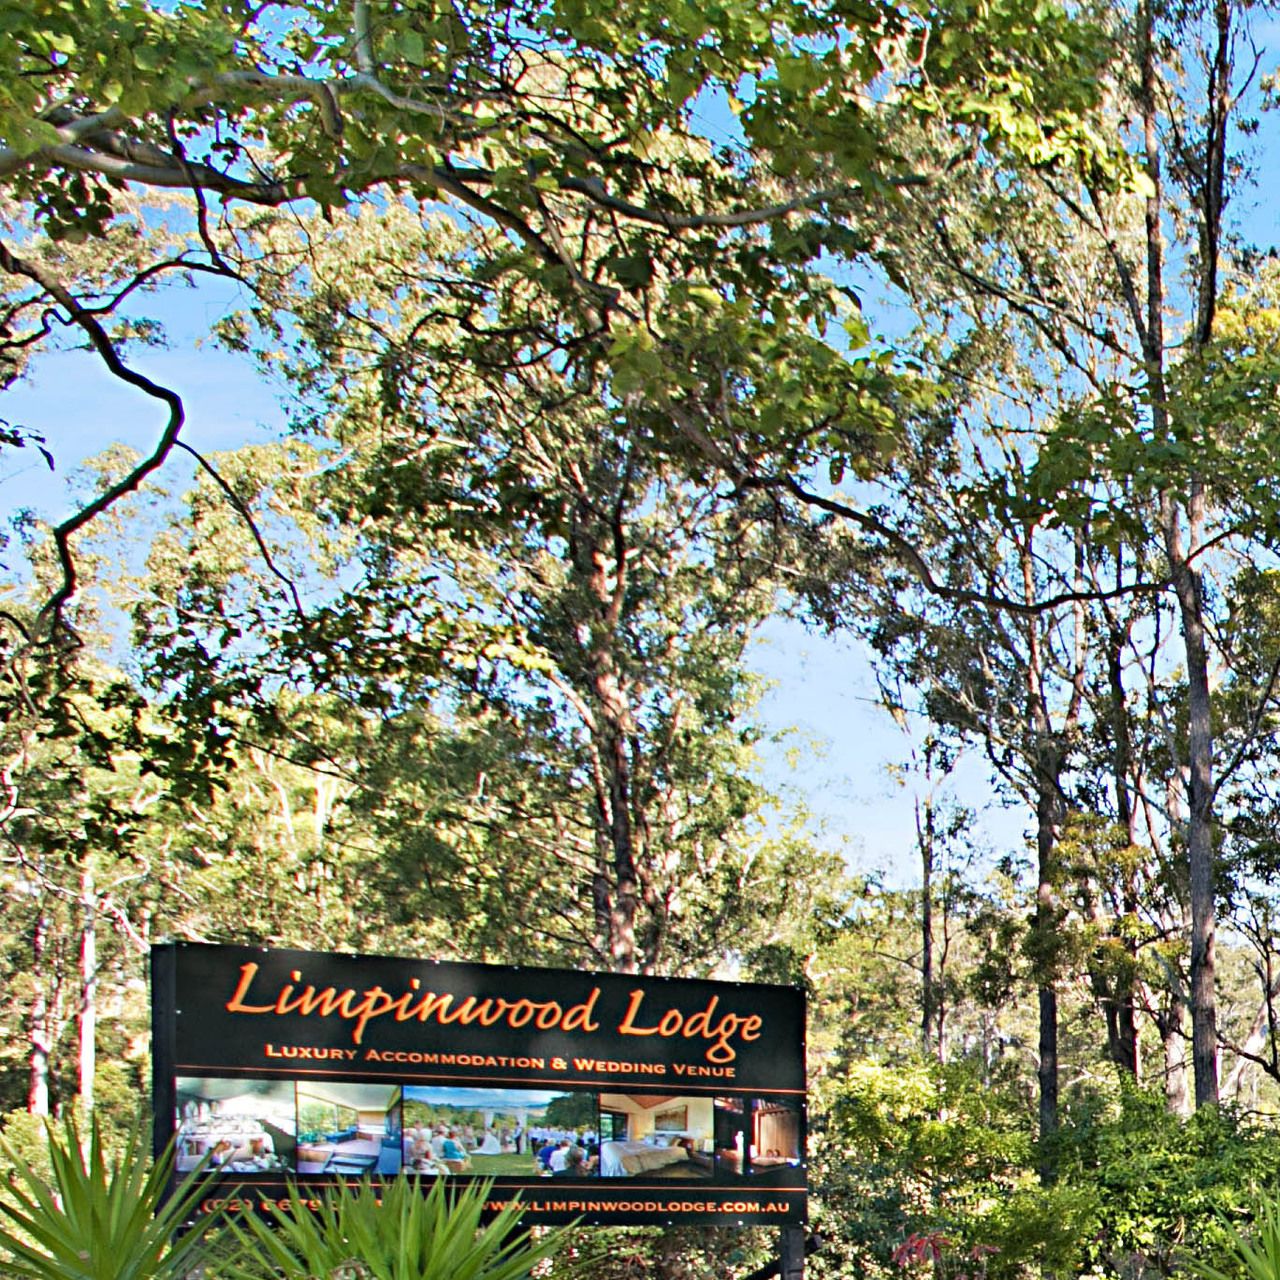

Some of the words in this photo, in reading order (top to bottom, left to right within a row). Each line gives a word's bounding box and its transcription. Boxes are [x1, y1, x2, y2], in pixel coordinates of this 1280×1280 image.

[224, 961, 600, 1044] Limpinwood
[617, 989, 762, 1063] Lodge
[551, 1057, 568, 1071] &
